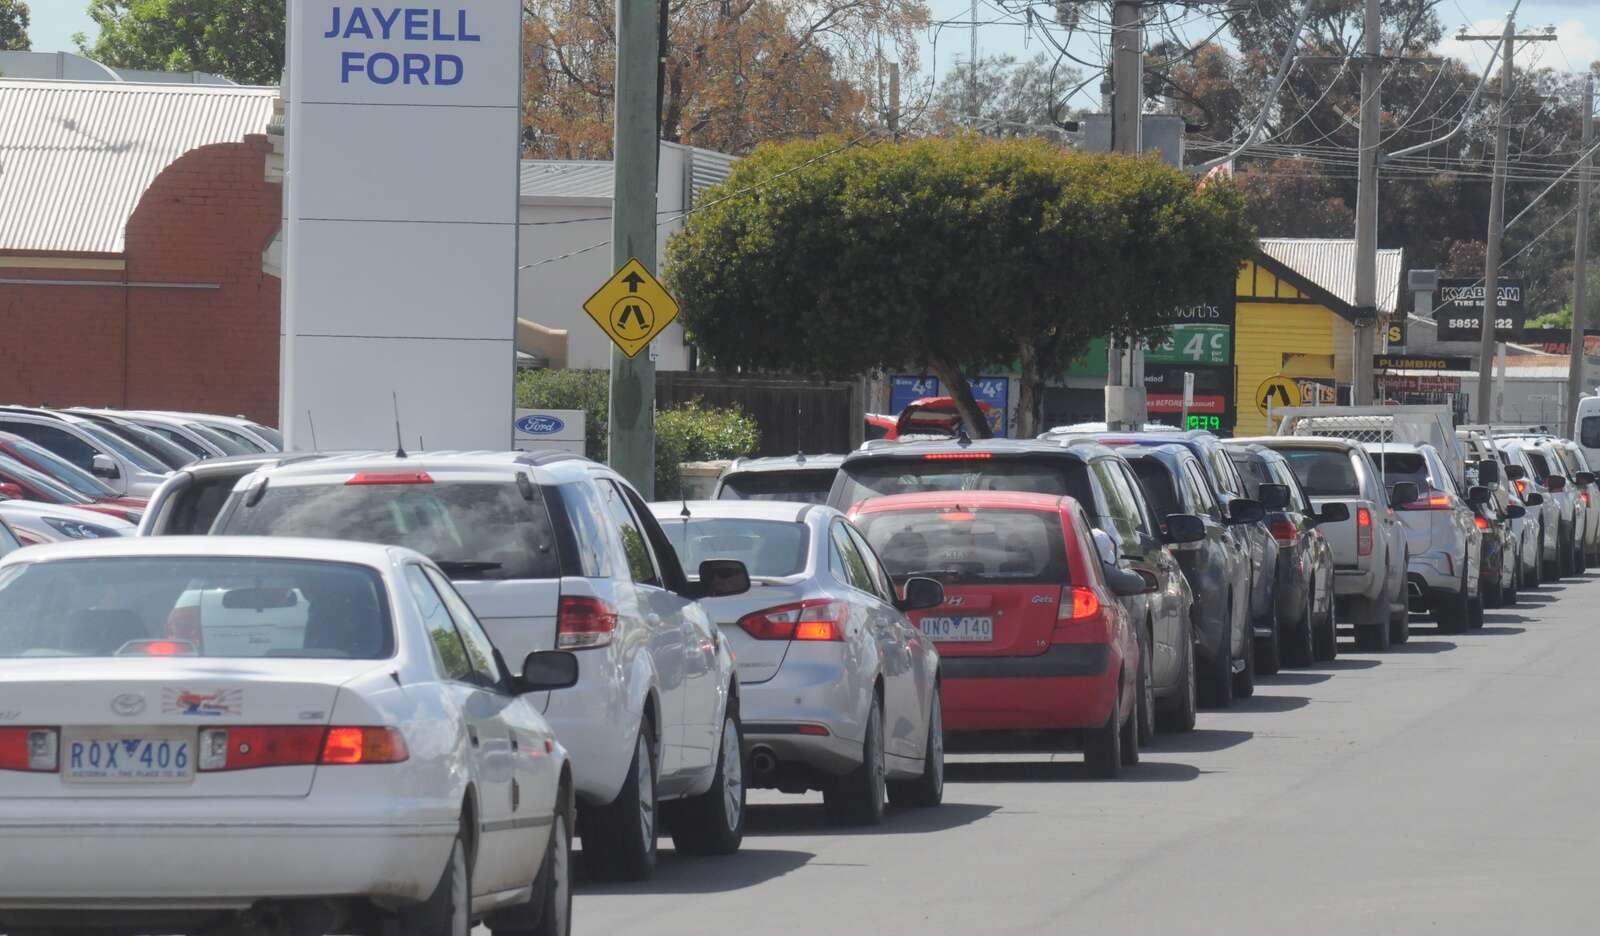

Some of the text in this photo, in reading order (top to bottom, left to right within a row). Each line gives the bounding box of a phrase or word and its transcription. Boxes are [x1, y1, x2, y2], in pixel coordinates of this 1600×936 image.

[324, 6, 481, 42] JAYELL
[341, 51, 464, 86] FORD
[1441, 286, 1520, 302] KYABAM
[1448, 318, 1480, 329] 5852
[1379, 358, 1447, 369] PLUMBING
[524, 416, 556, 432] Ford
[963, 620, 991, 635] 140
[71, 742, 188, 769] RQX 406
